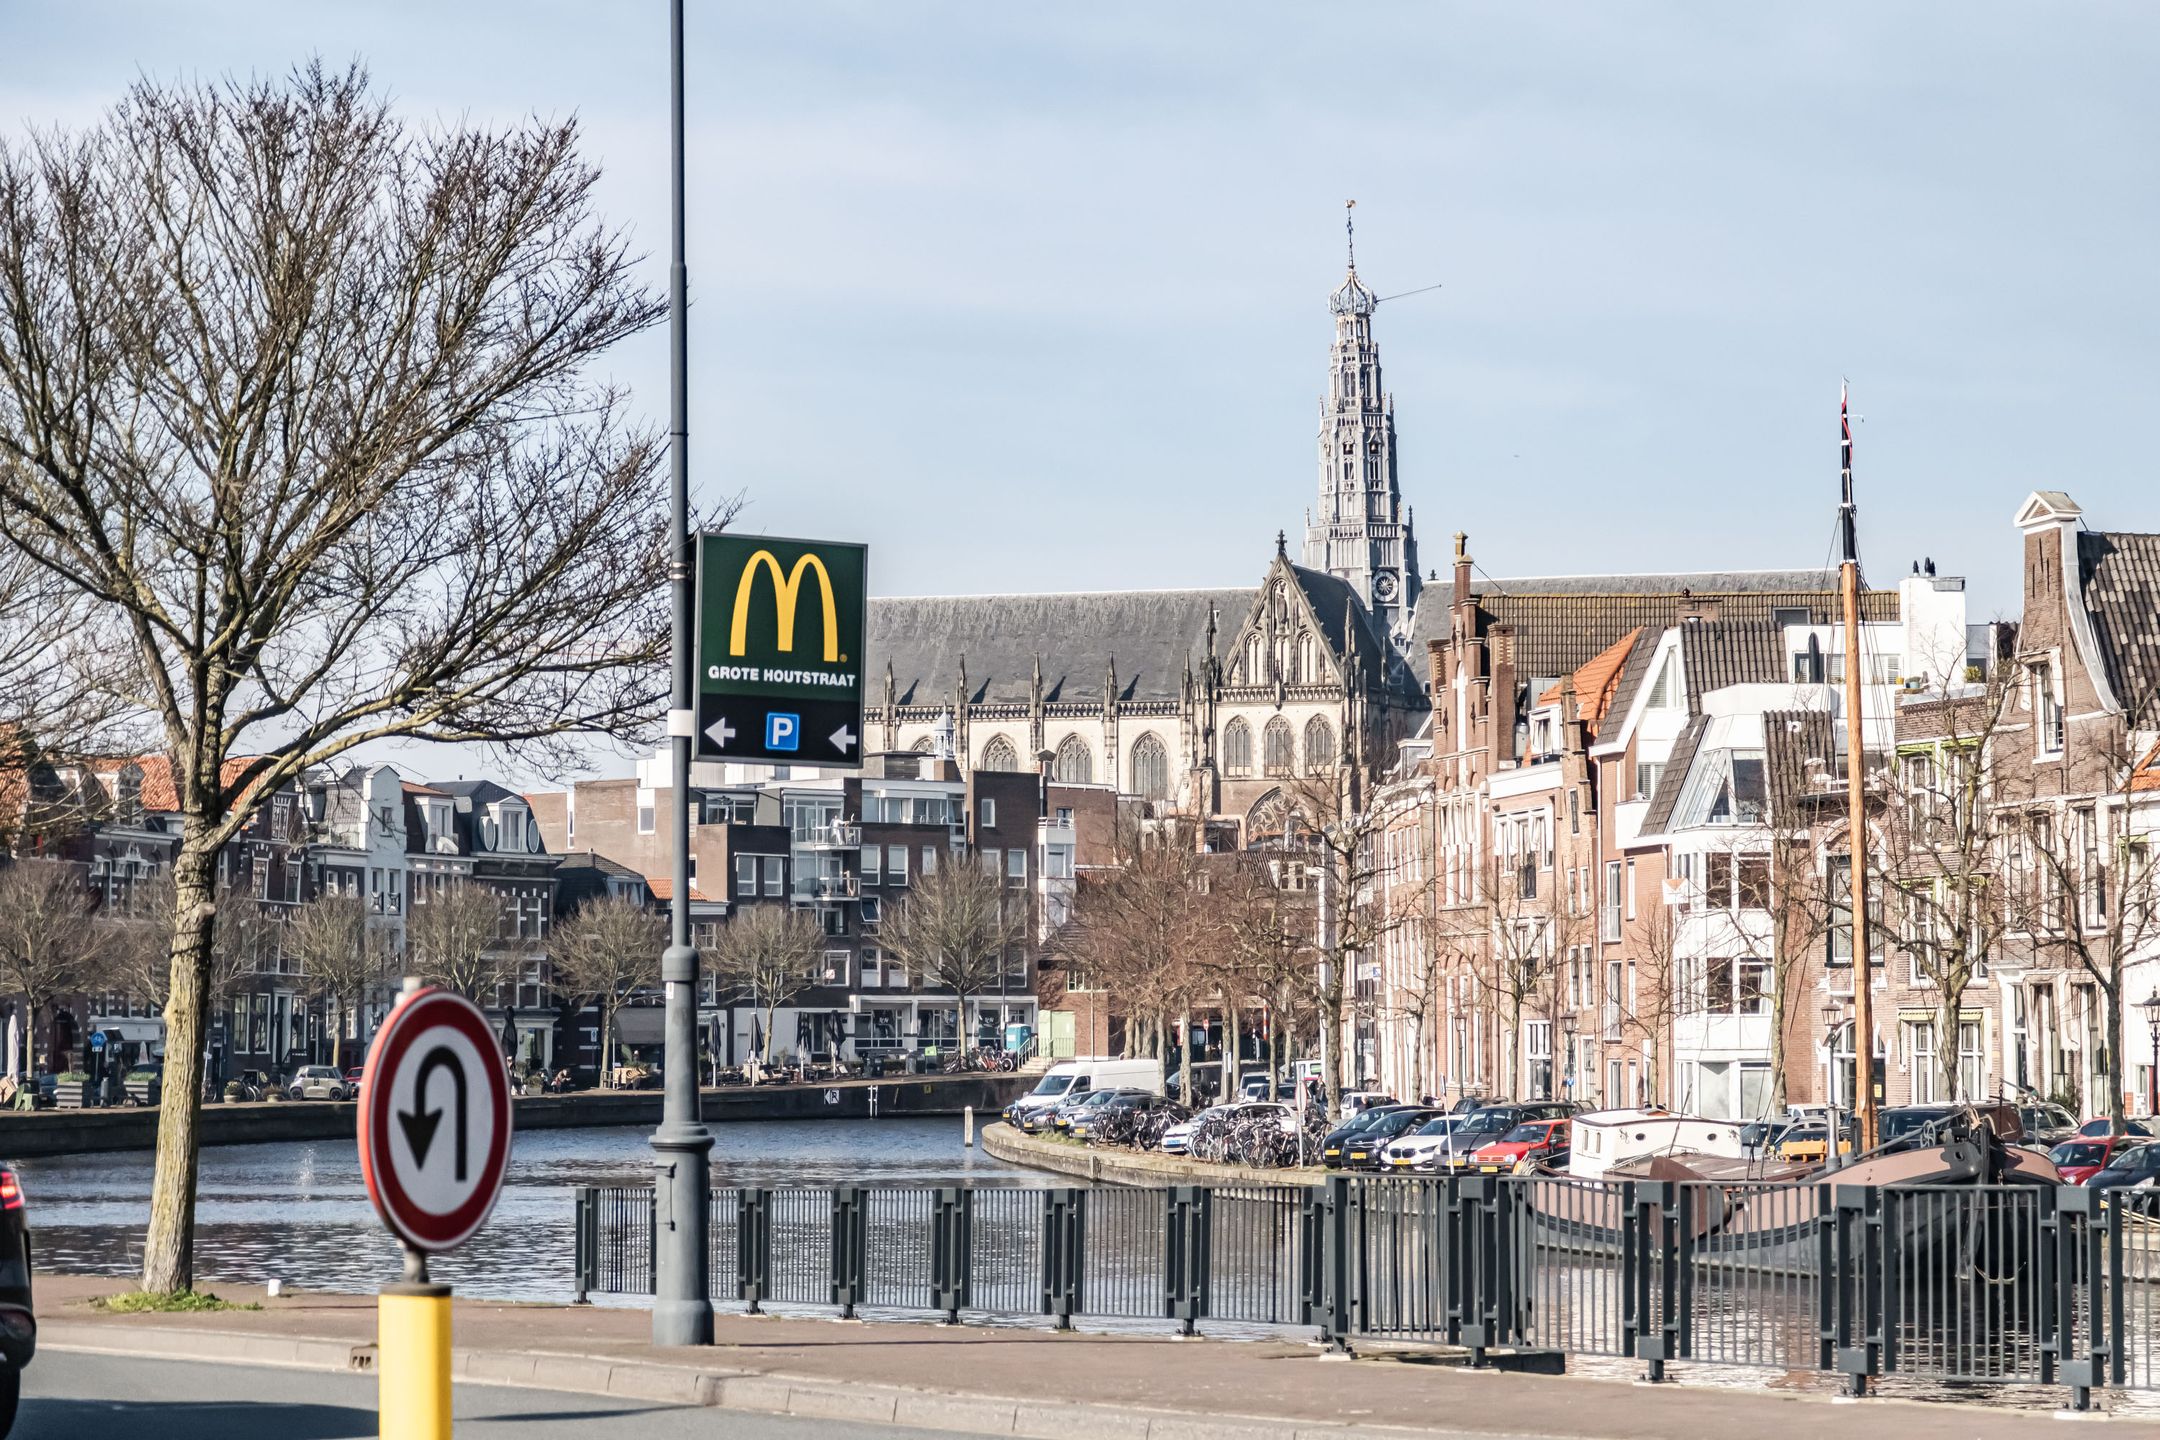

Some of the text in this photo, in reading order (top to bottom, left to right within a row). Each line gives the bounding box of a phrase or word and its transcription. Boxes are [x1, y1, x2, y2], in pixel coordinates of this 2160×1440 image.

[730, 549, 838, 662] M
[708, 665, 856, 687] GROTE HOUTSTRAAT
[772, 717, 793, 746] P
